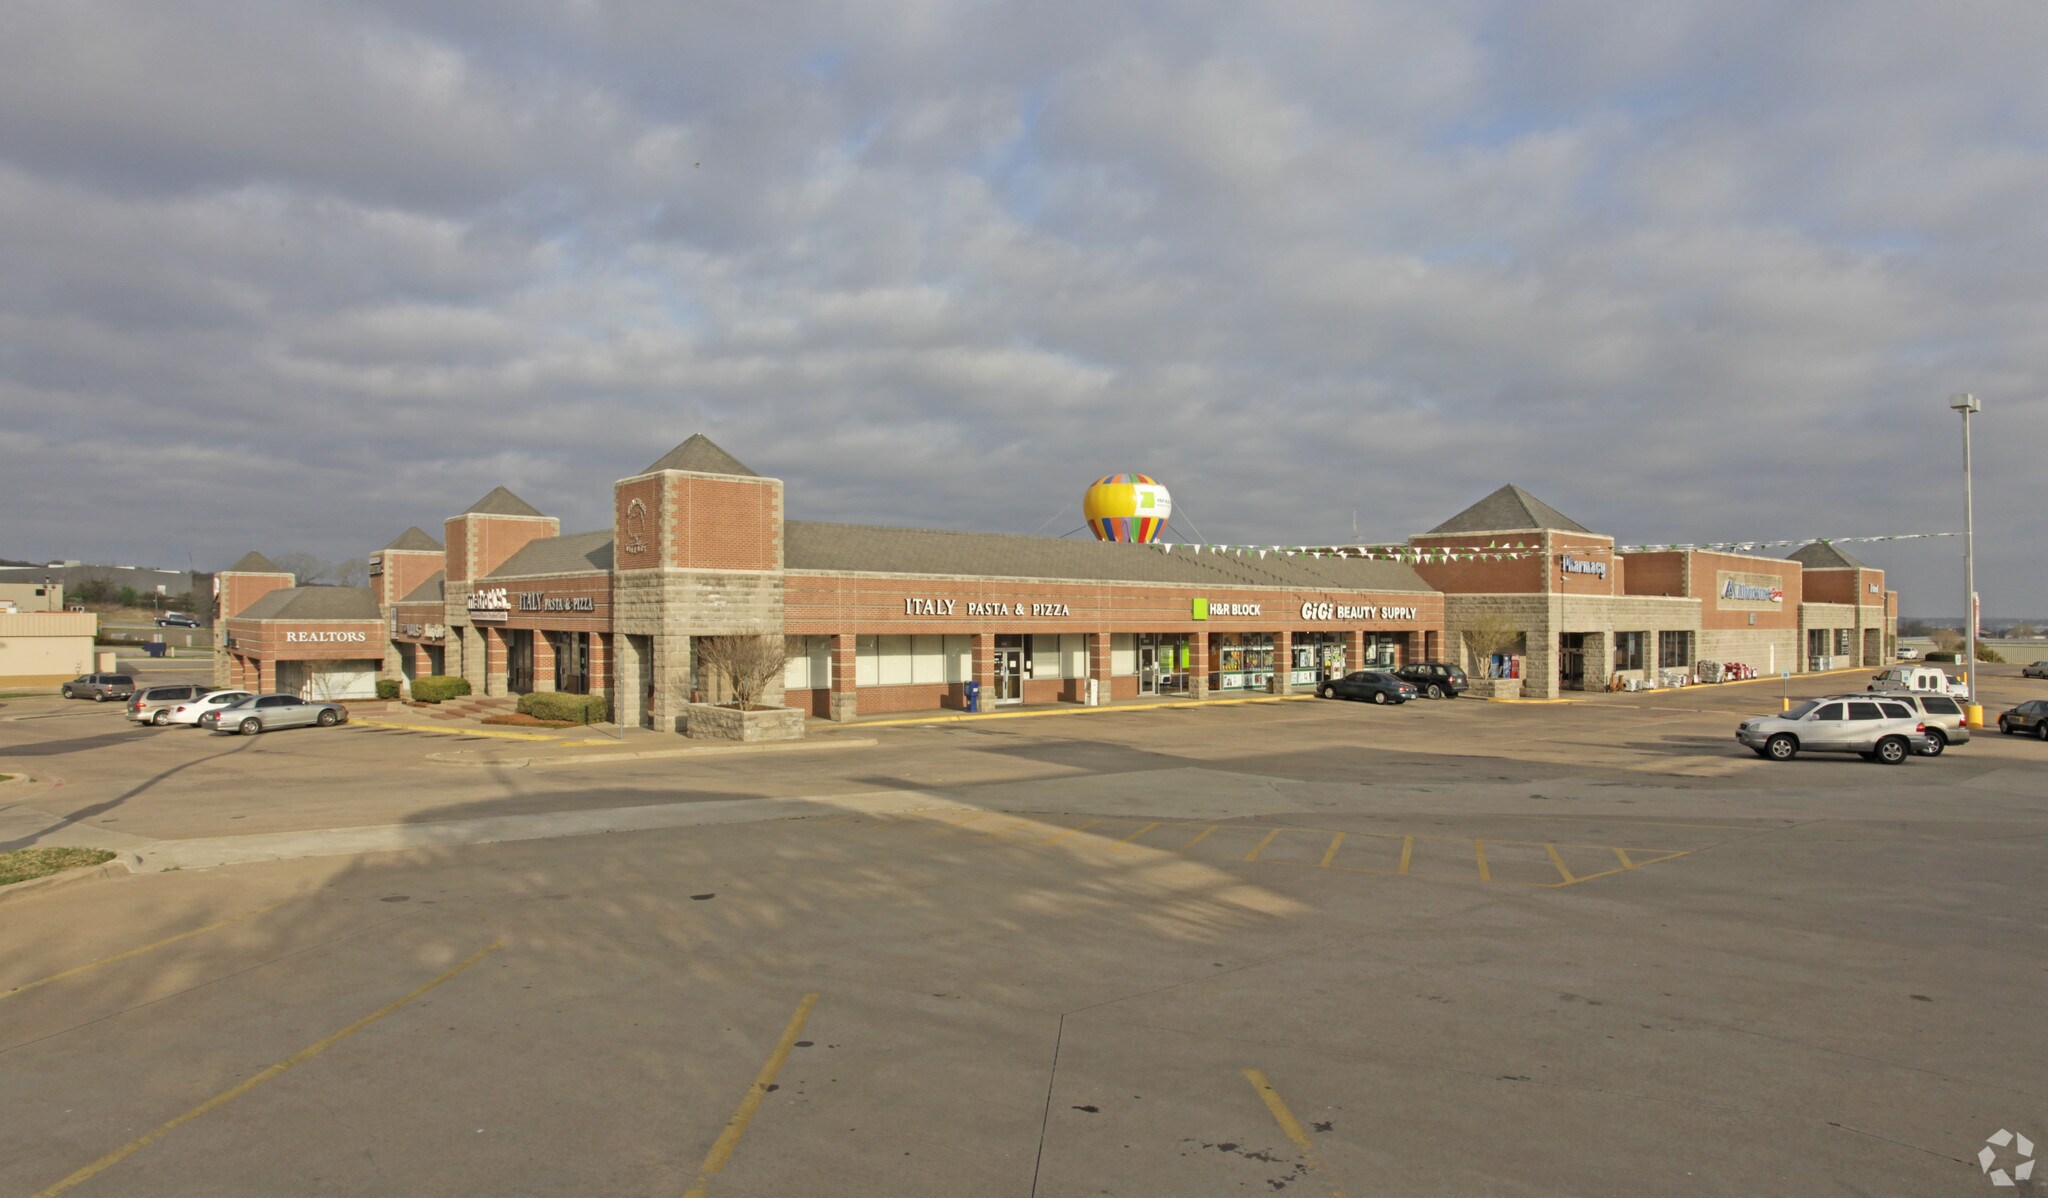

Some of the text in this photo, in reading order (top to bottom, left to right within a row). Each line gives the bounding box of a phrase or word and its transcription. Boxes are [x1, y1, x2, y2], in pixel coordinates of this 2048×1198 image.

[519, 592, 543, 611] ITALY
[544, 598, 563, 611] PASTA
[573, 597, 594, 611] PIZZA
[904, 598, 1070, 617] ITALY PASTA & PIZZA
[1209, 603, 1261, 616] H&R BLOCK
[1336, 606, 1377, 619] BEAUTY
[1380, 607, 1417, 620] SUPPLY
[286, 631, 366, 642] REALTORS
